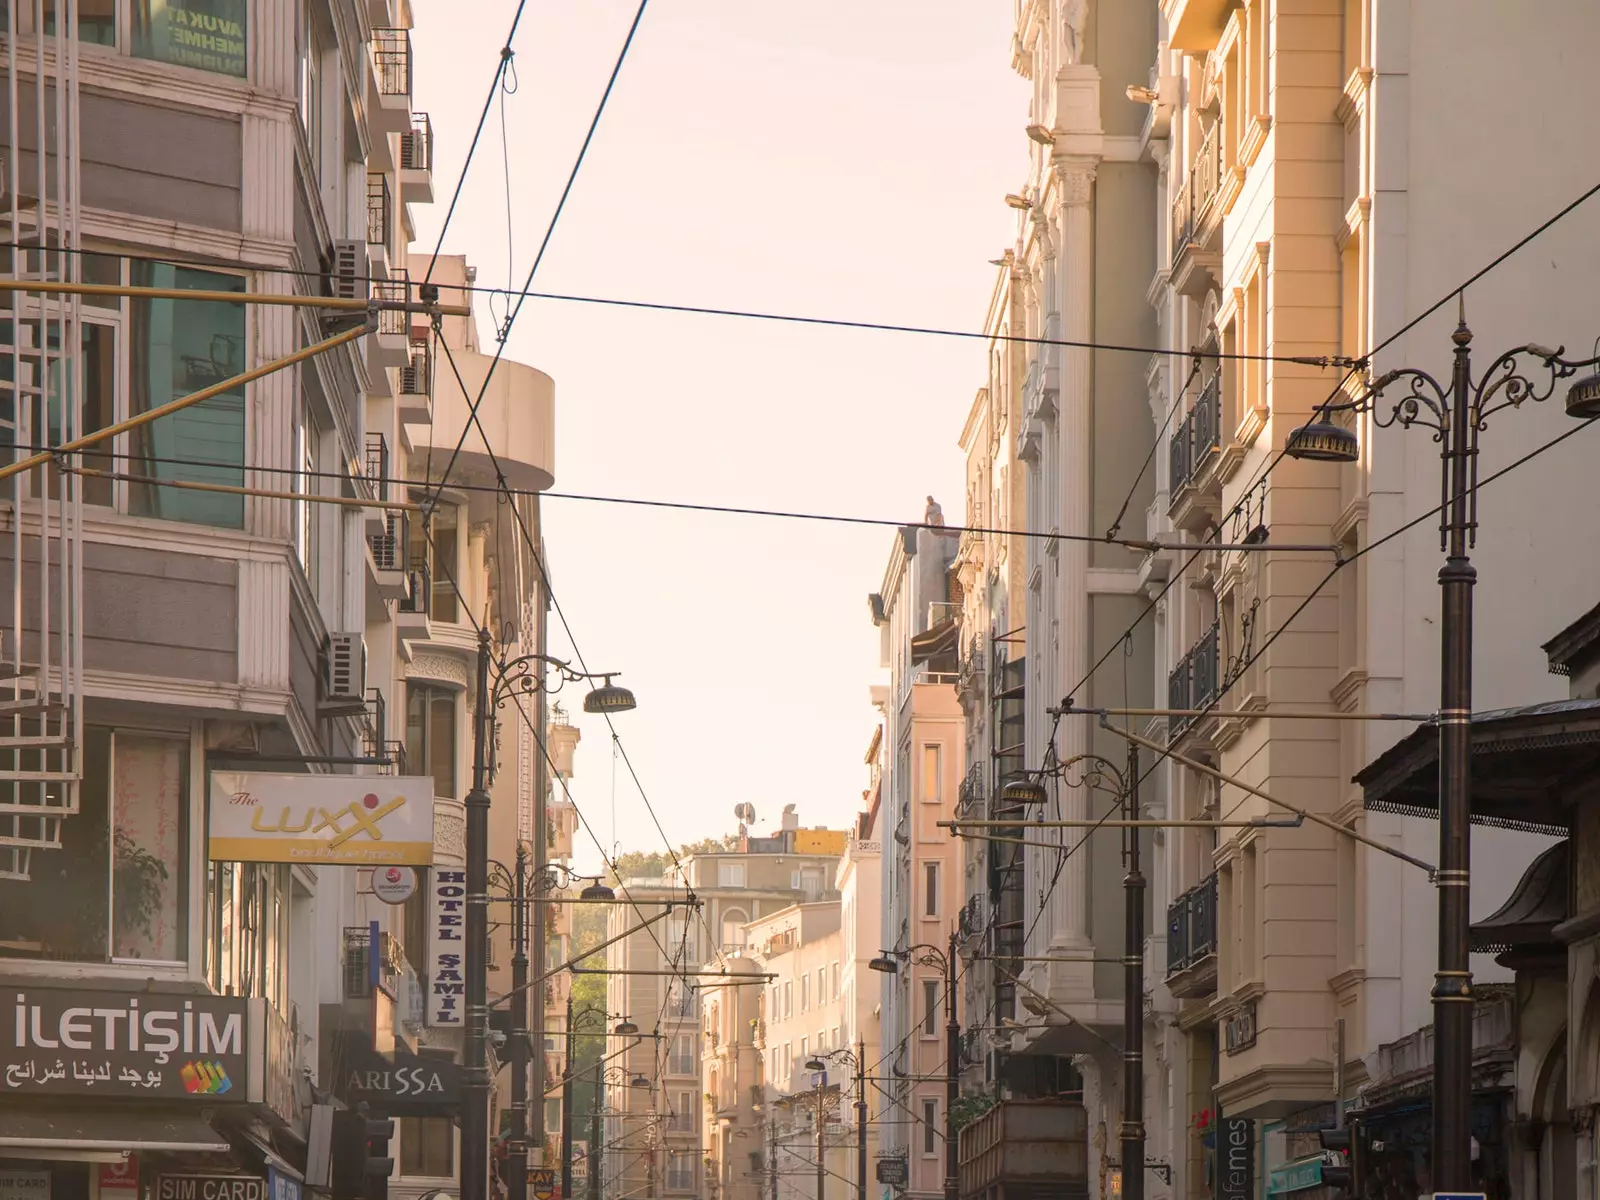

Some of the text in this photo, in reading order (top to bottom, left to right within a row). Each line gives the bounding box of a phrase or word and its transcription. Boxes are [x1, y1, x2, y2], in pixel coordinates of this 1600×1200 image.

[229, 792, 259, 806] The
[289, 847, 405, 860] boutique hotel
[434, 872, 465, 1022] HOTEL ŞAMİL
[16, 993, 242, 1064] İLETİŞİM
[6, 1059, 162, 1089] يوجد لدينا شرائح
[349, 1067, 444, 1095] ARISSA
[17, 1178, 47, 1189] CARD
[162, 1180, 196, 1200] SIM
